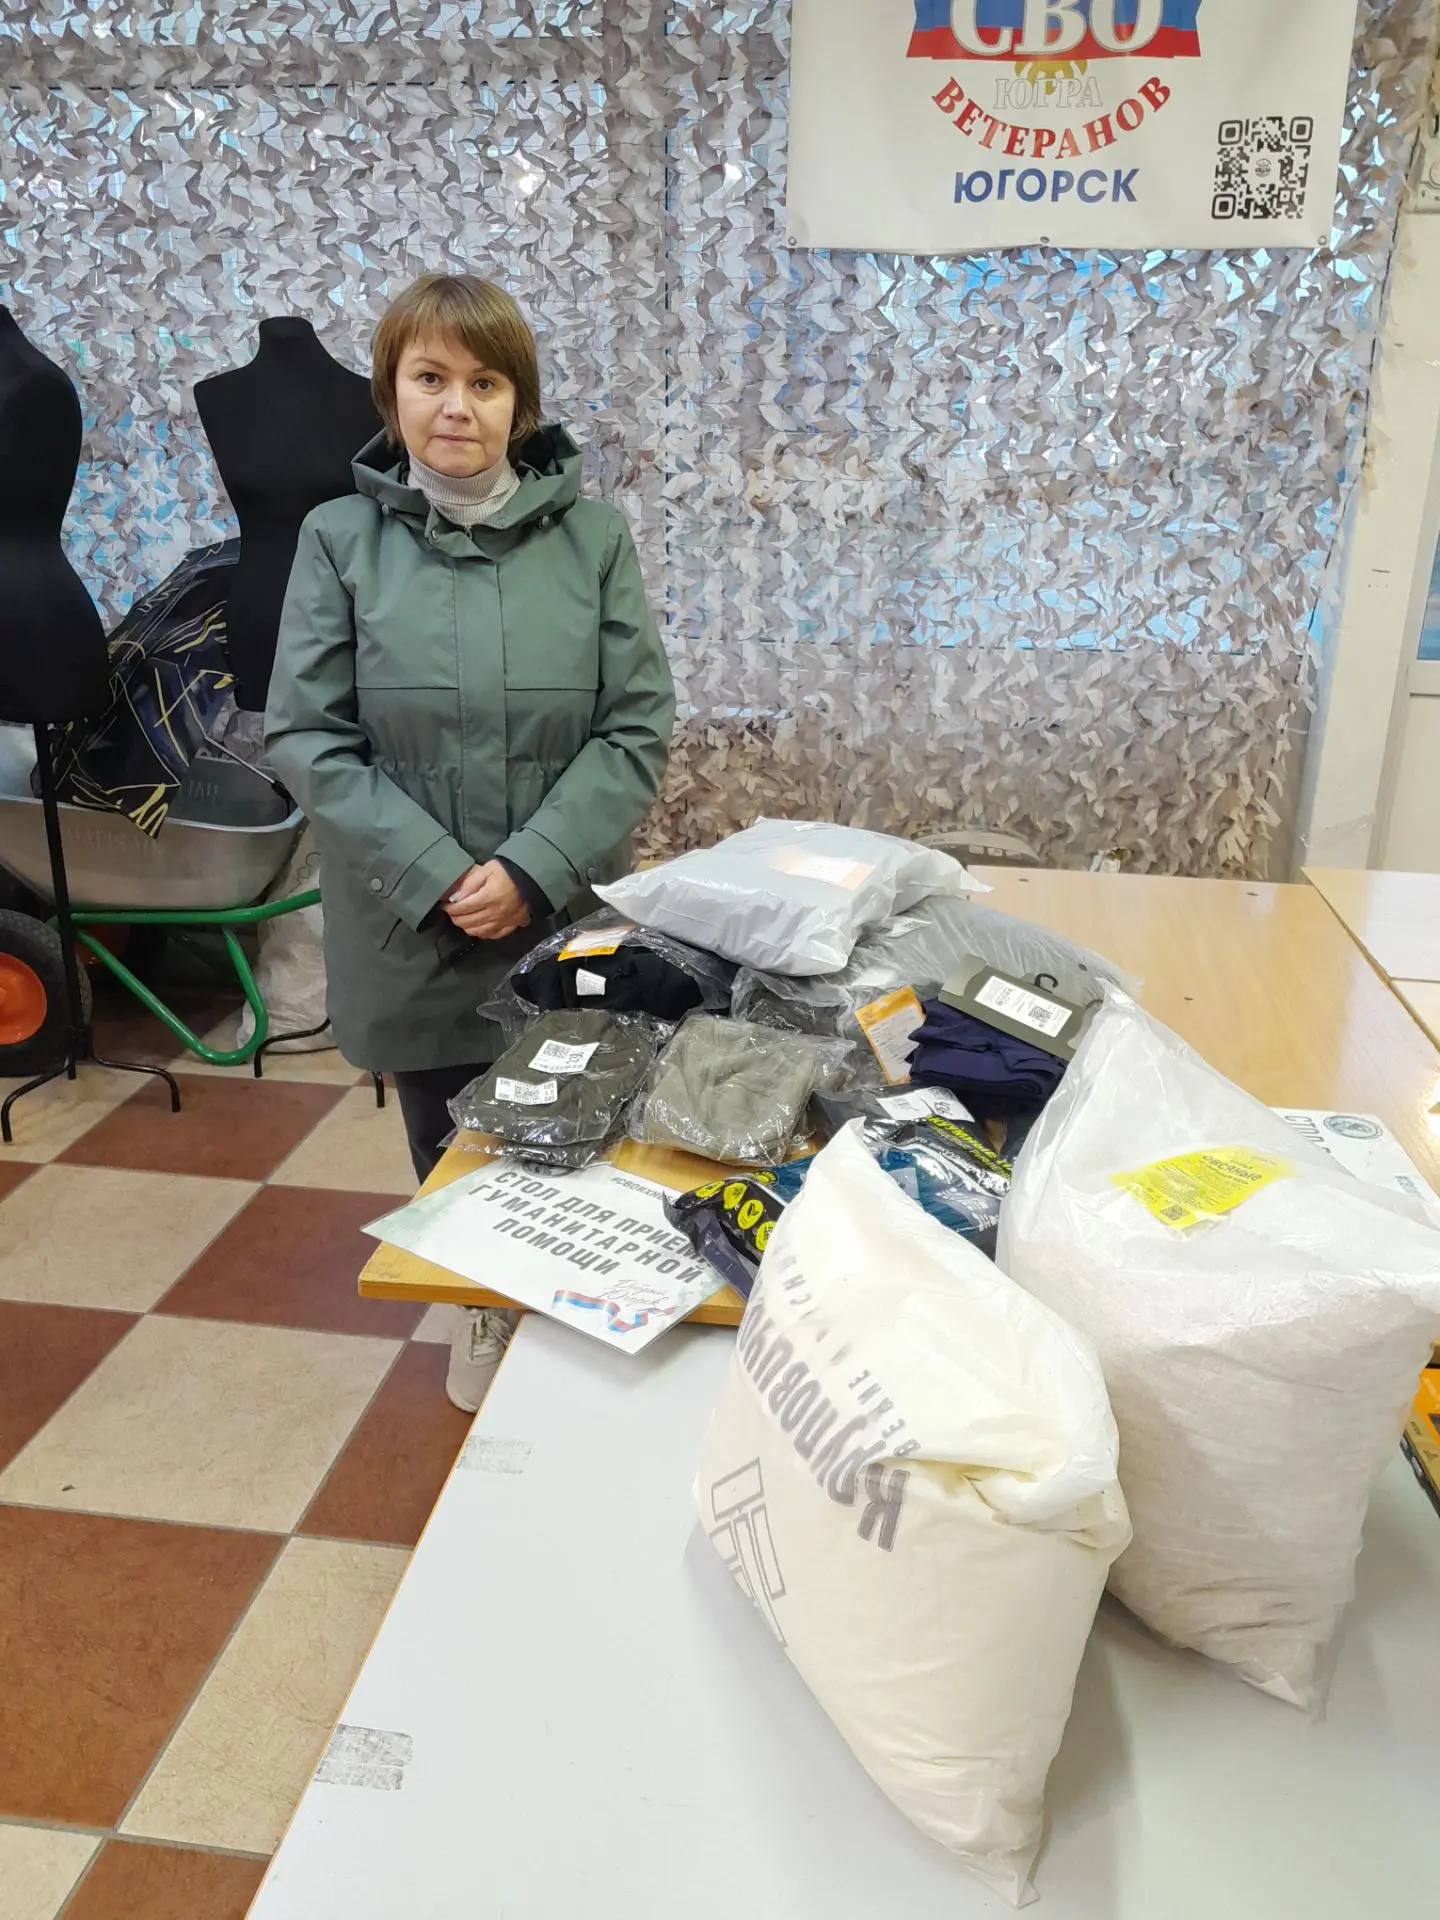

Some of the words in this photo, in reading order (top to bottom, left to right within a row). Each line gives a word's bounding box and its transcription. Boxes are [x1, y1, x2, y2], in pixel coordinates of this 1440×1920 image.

[950, 0, 1164, 56] СВО
[931, 76, 1171, 159] ВЕТЕРАНОВ
[993, 76, 1103, 109] ЮГРА
[954, 168, 1140, 203] ЮГОРСК
[468, 1184, 705, 1284] ГУМАНИТАРНОЙ
[492, 1217, 621, 1275] ПОМОЩИ
[494, 1171, 561, 1199] СТОЛ
[552, 1196, 617, 1224] ДЛЯ
[613, 1217, 711, 1267] ПРИЕМ
[738, 1276, 911, 1553] КРУПОВИЧО
